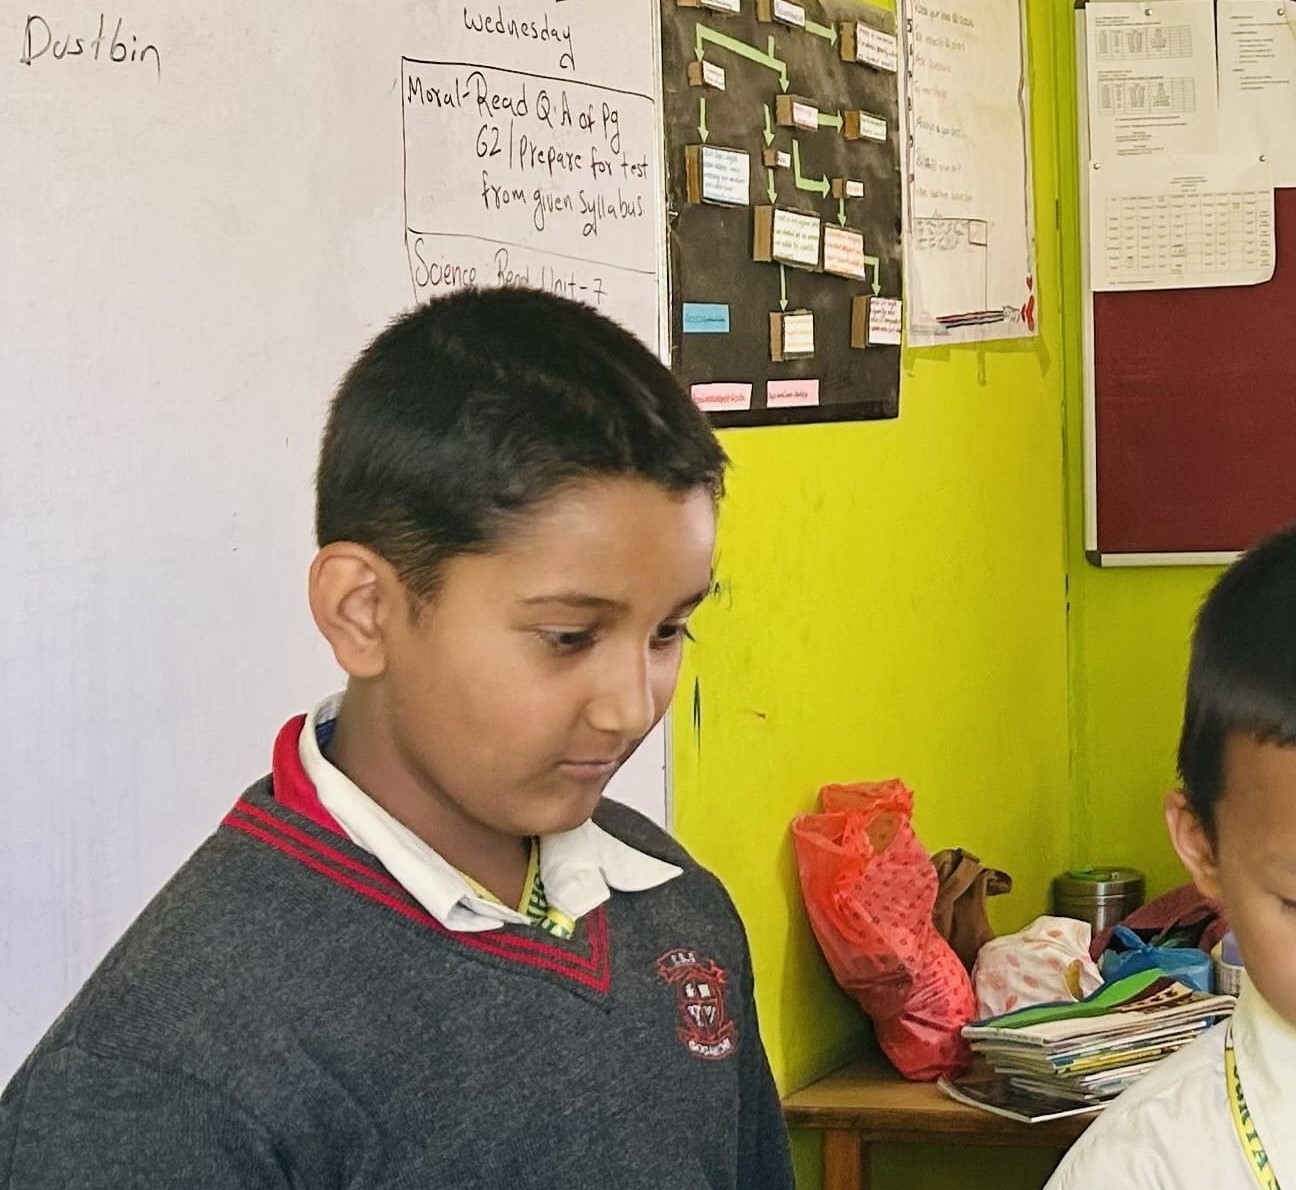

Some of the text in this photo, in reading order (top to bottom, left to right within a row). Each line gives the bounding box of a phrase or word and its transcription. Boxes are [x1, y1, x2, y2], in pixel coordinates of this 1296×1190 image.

[20, 13, 161, 86] Dustbin
[579, 104, 596, 135] of
[591, 146, 614, 181] for
[620, 151, 650, 181] test
[482, 169, 528, 210] from
[533, 188, 574, 232] given
[414, 238, 477, 287] Science
